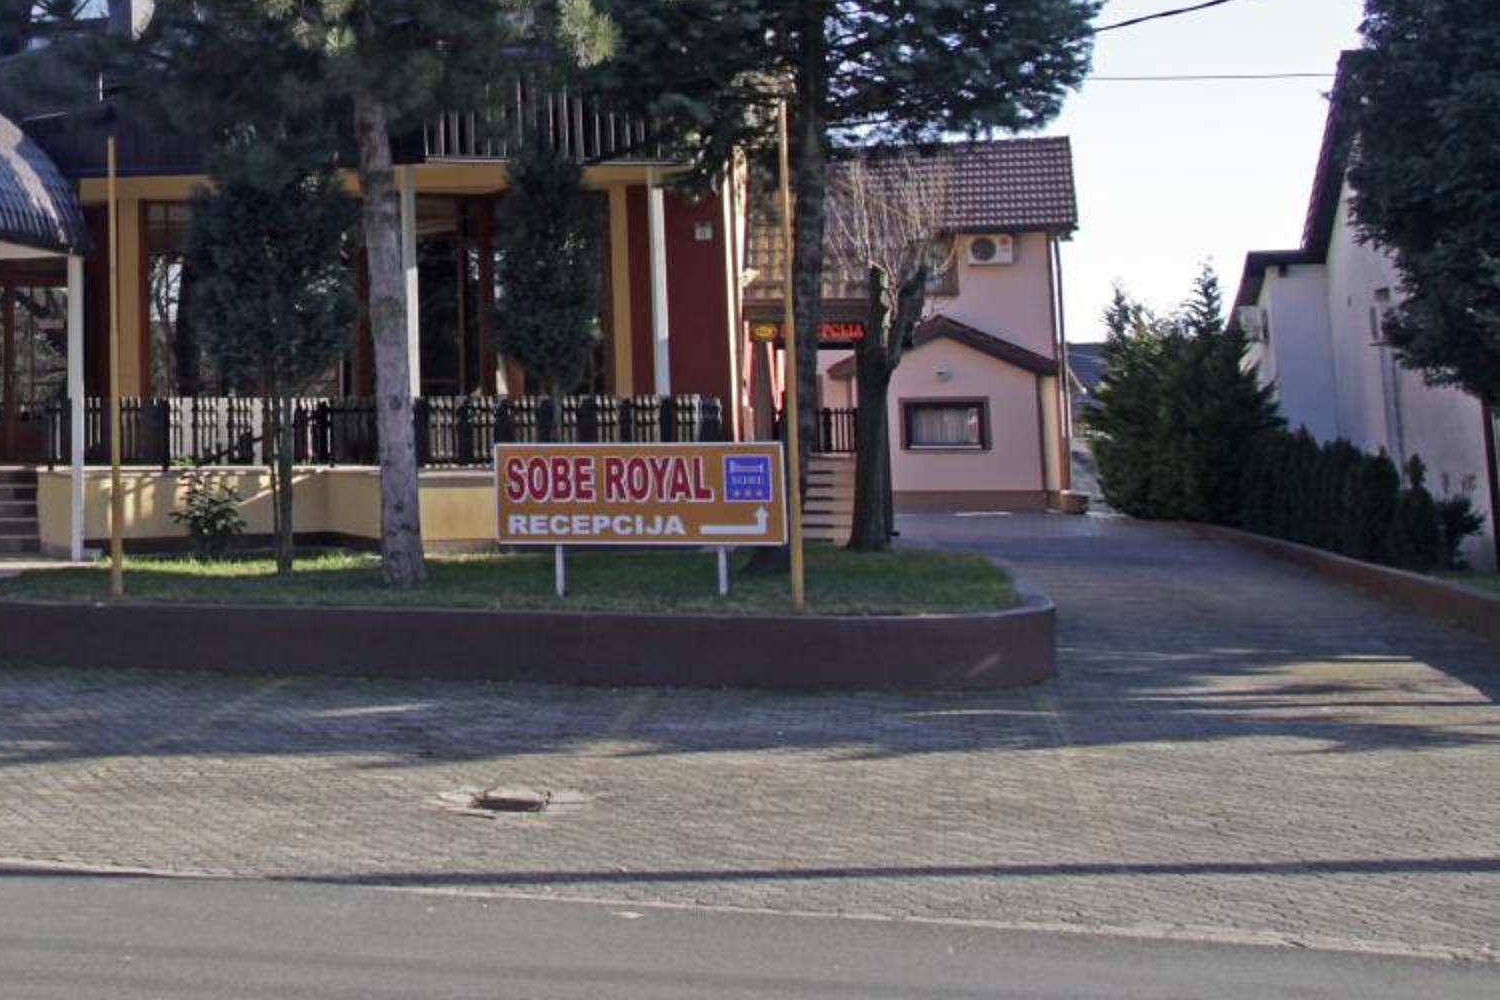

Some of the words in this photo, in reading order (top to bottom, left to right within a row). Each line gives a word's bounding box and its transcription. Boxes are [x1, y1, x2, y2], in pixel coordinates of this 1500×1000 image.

[506, 456, 596, 502] SOBE
[603, 456, 714, 502] ROYAL
[508, 514, 686, 535] RECEPCIJA
